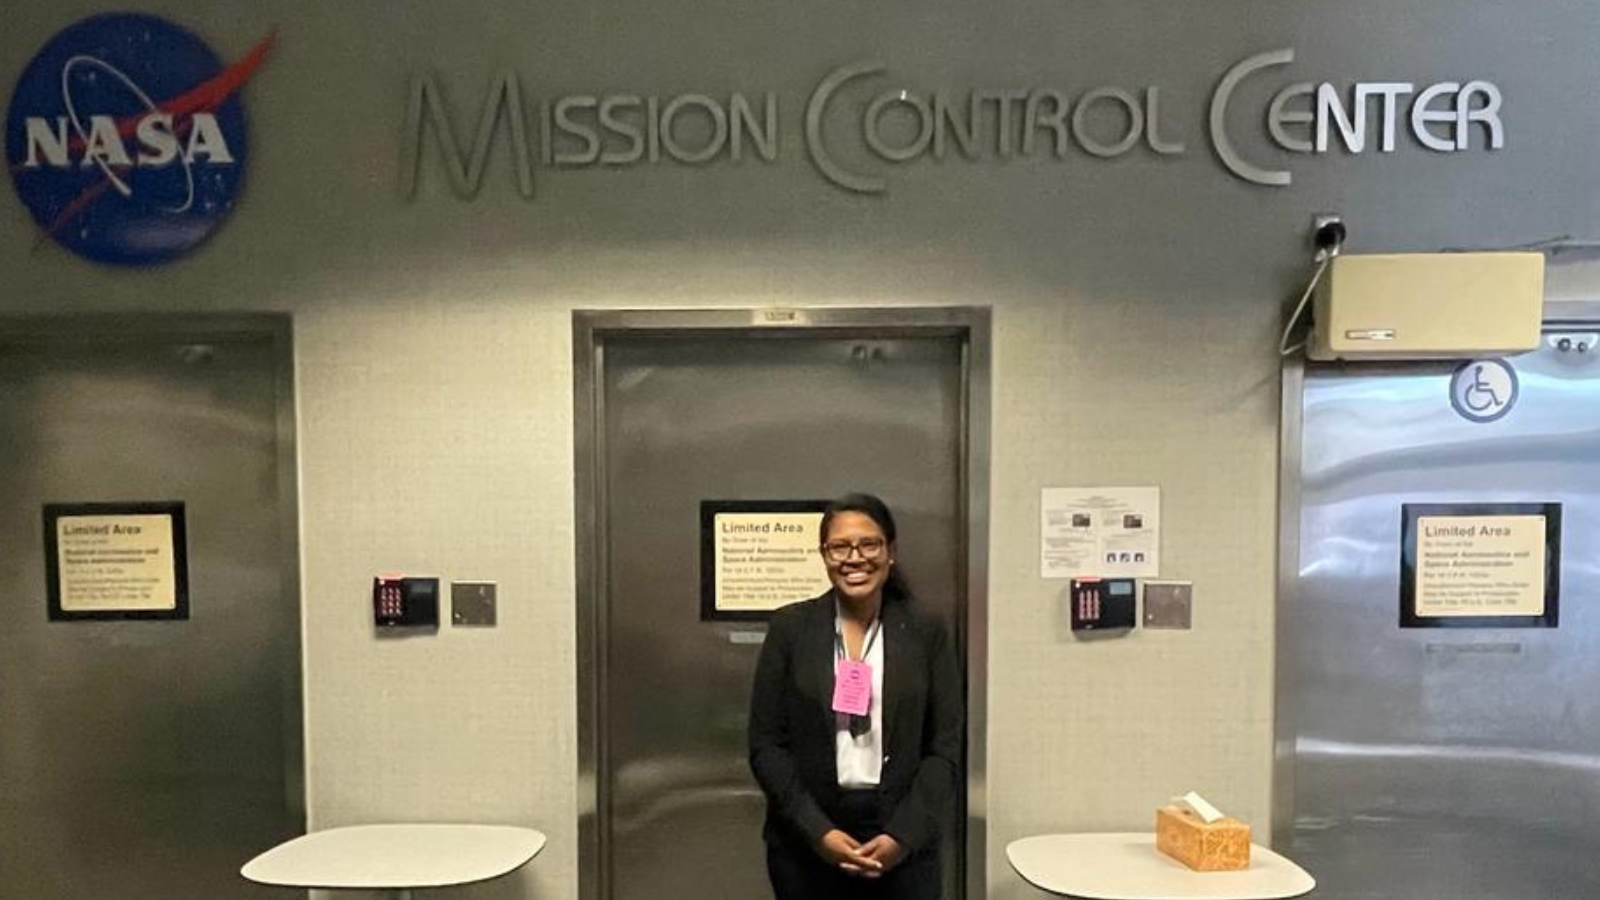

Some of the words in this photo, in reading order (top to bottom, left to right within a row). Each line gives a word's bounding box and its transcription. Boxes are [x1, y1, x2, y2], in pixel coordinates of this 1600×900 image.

[24, 113, 234, 169] NASA
[63, 524, 109, 535] Limited
[113, 524, 141, 535] Area
[722, 522, 770, 533] Limited
[774, 522, 803, 533] Area
[1425, 525, 1475, 537] Limited
[1479, 525, 1511, 537] Area
